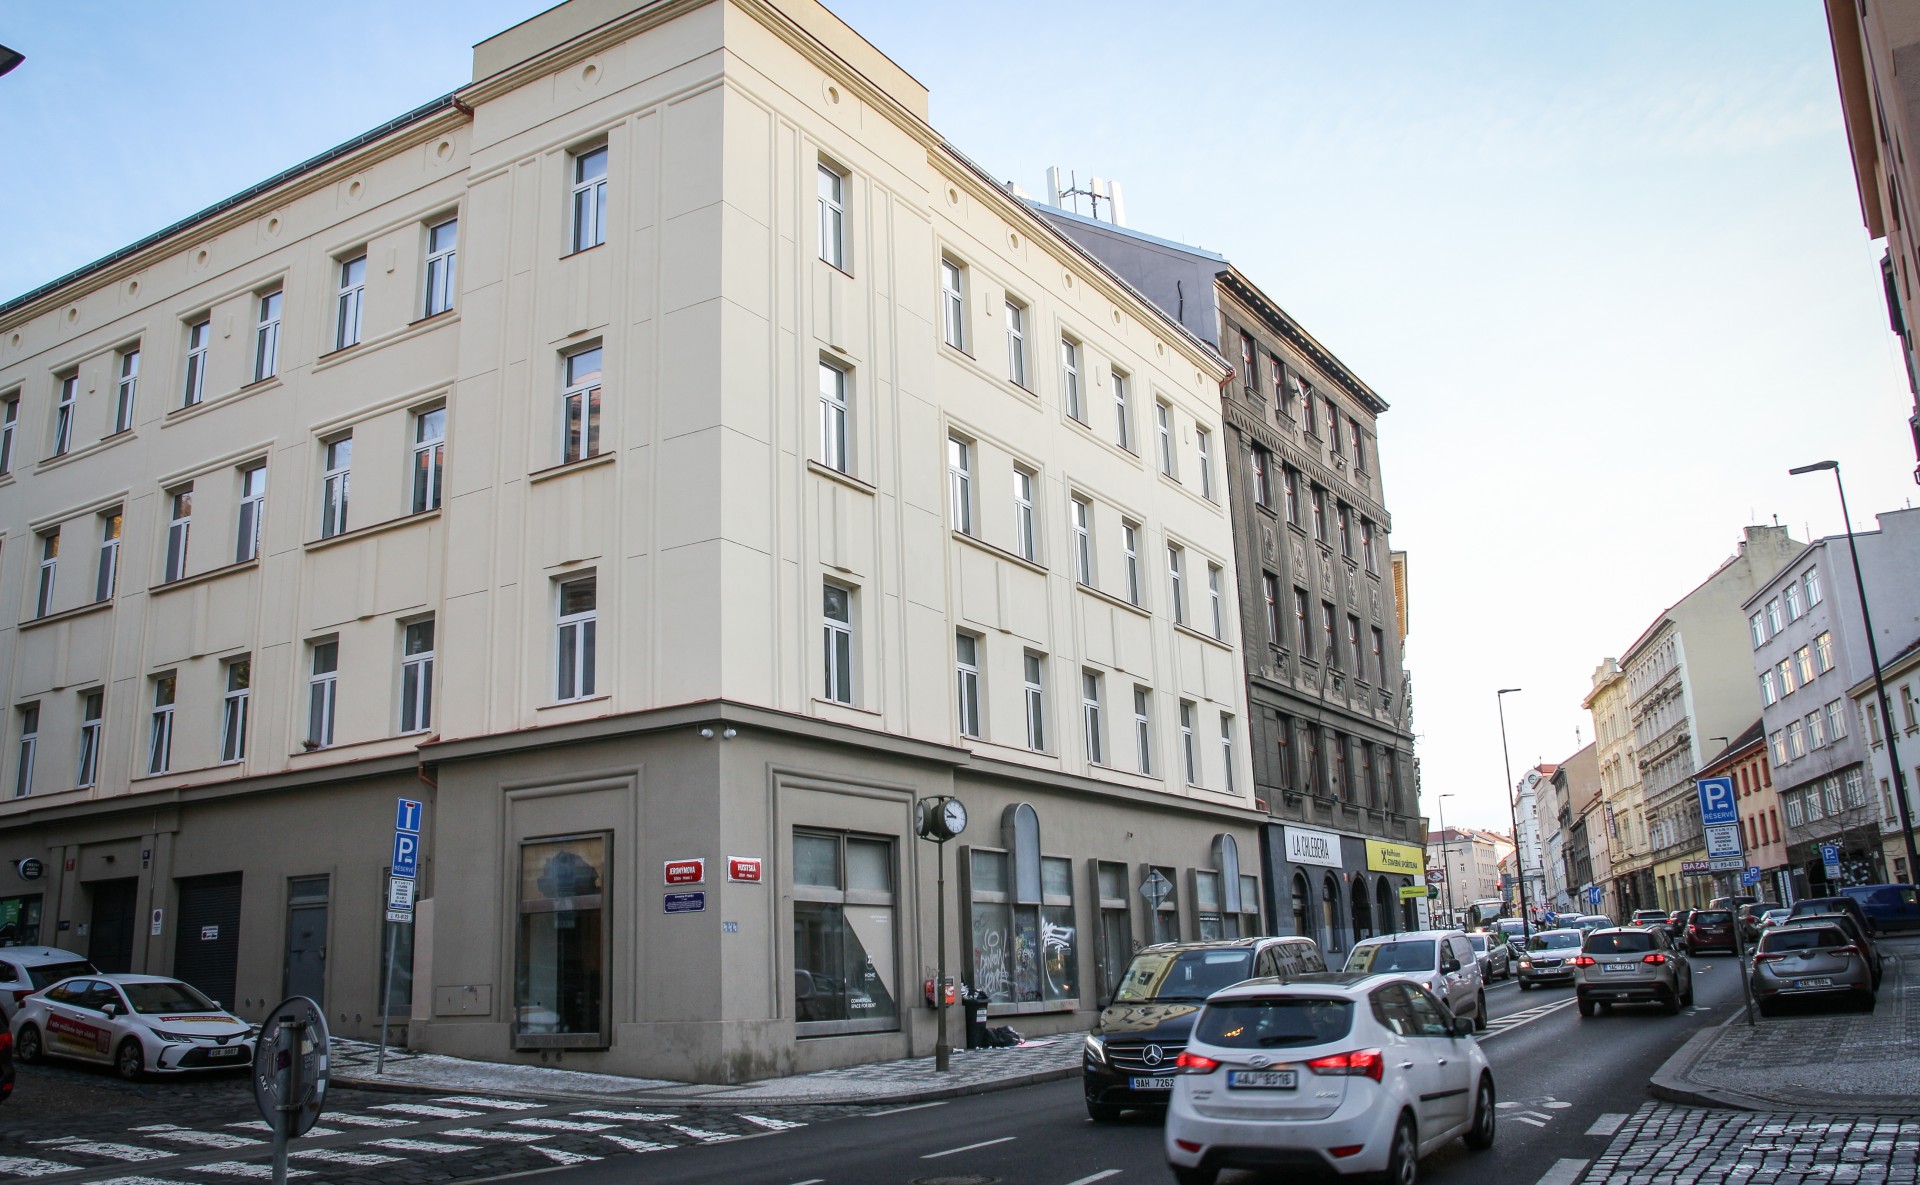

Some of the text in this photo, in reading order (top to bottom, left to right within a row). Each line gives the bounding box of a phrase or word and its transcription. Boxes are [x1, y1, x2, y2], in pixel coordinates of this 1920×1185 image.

[1705, 784, 1726, 810] P
[398, 837, 413, 863] P
[1292, 834, 1301, 856] LA
[1824, 848, 1834, 859] P
[1750, 868, 1757, 877] P
[1135, 1078, 1175, 1088] 9AH 7262
